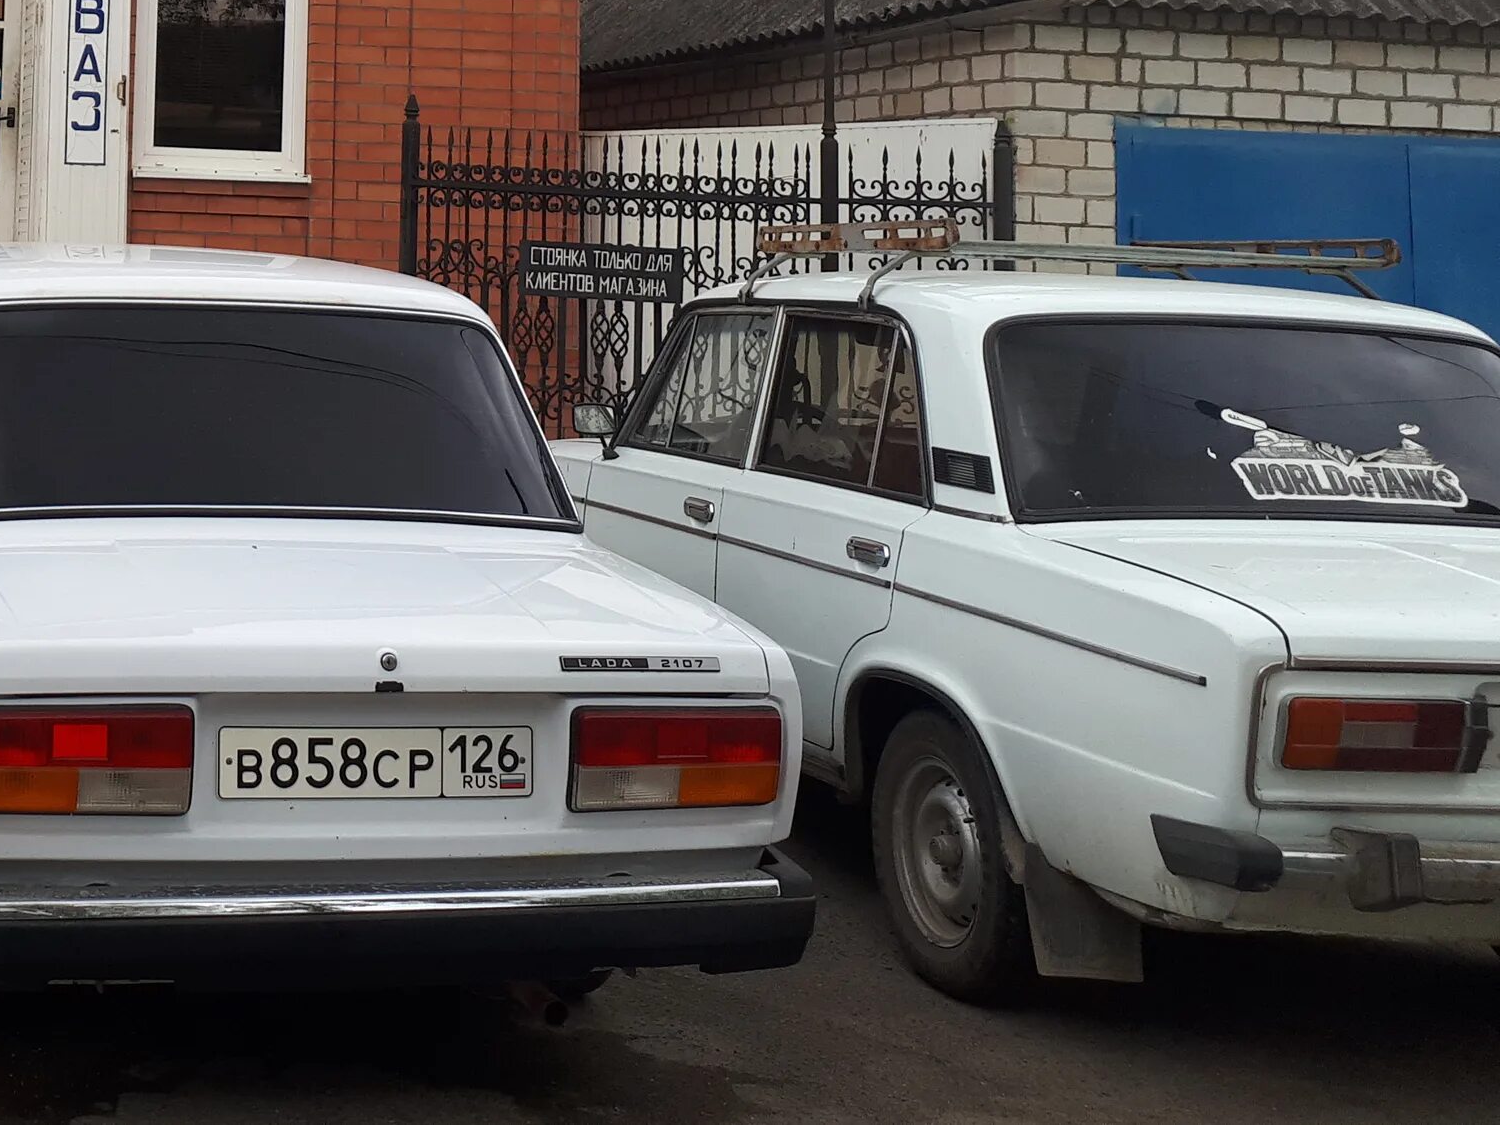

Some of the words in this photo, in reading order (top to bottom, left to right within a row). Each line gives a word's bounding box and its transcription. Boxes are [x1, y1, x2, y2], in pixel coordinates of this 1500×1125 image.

[530, 246, 587, 268] СТОЯНКА
[593, 250, 642, 271] ТОЛЬКО
[644, 253, 673, 273] ДЛЯ
[525, 271, 594, 293] КЛИЕНТОВ
[599, 276, 668, 298] МАГАЗИНА
[1239, 463, 1351, 496] WORLD
[1349, 475, 1375, 498] OF
[1362, 466, 1464, 503] TANKS
[578, 658, 633, 668] LADA
[660, 659, 704, 668] 2107
[235, 736, 435, 790] В858СР
[448, 733, 520, 774] 126
[461, 776, 499, 790] RUS
